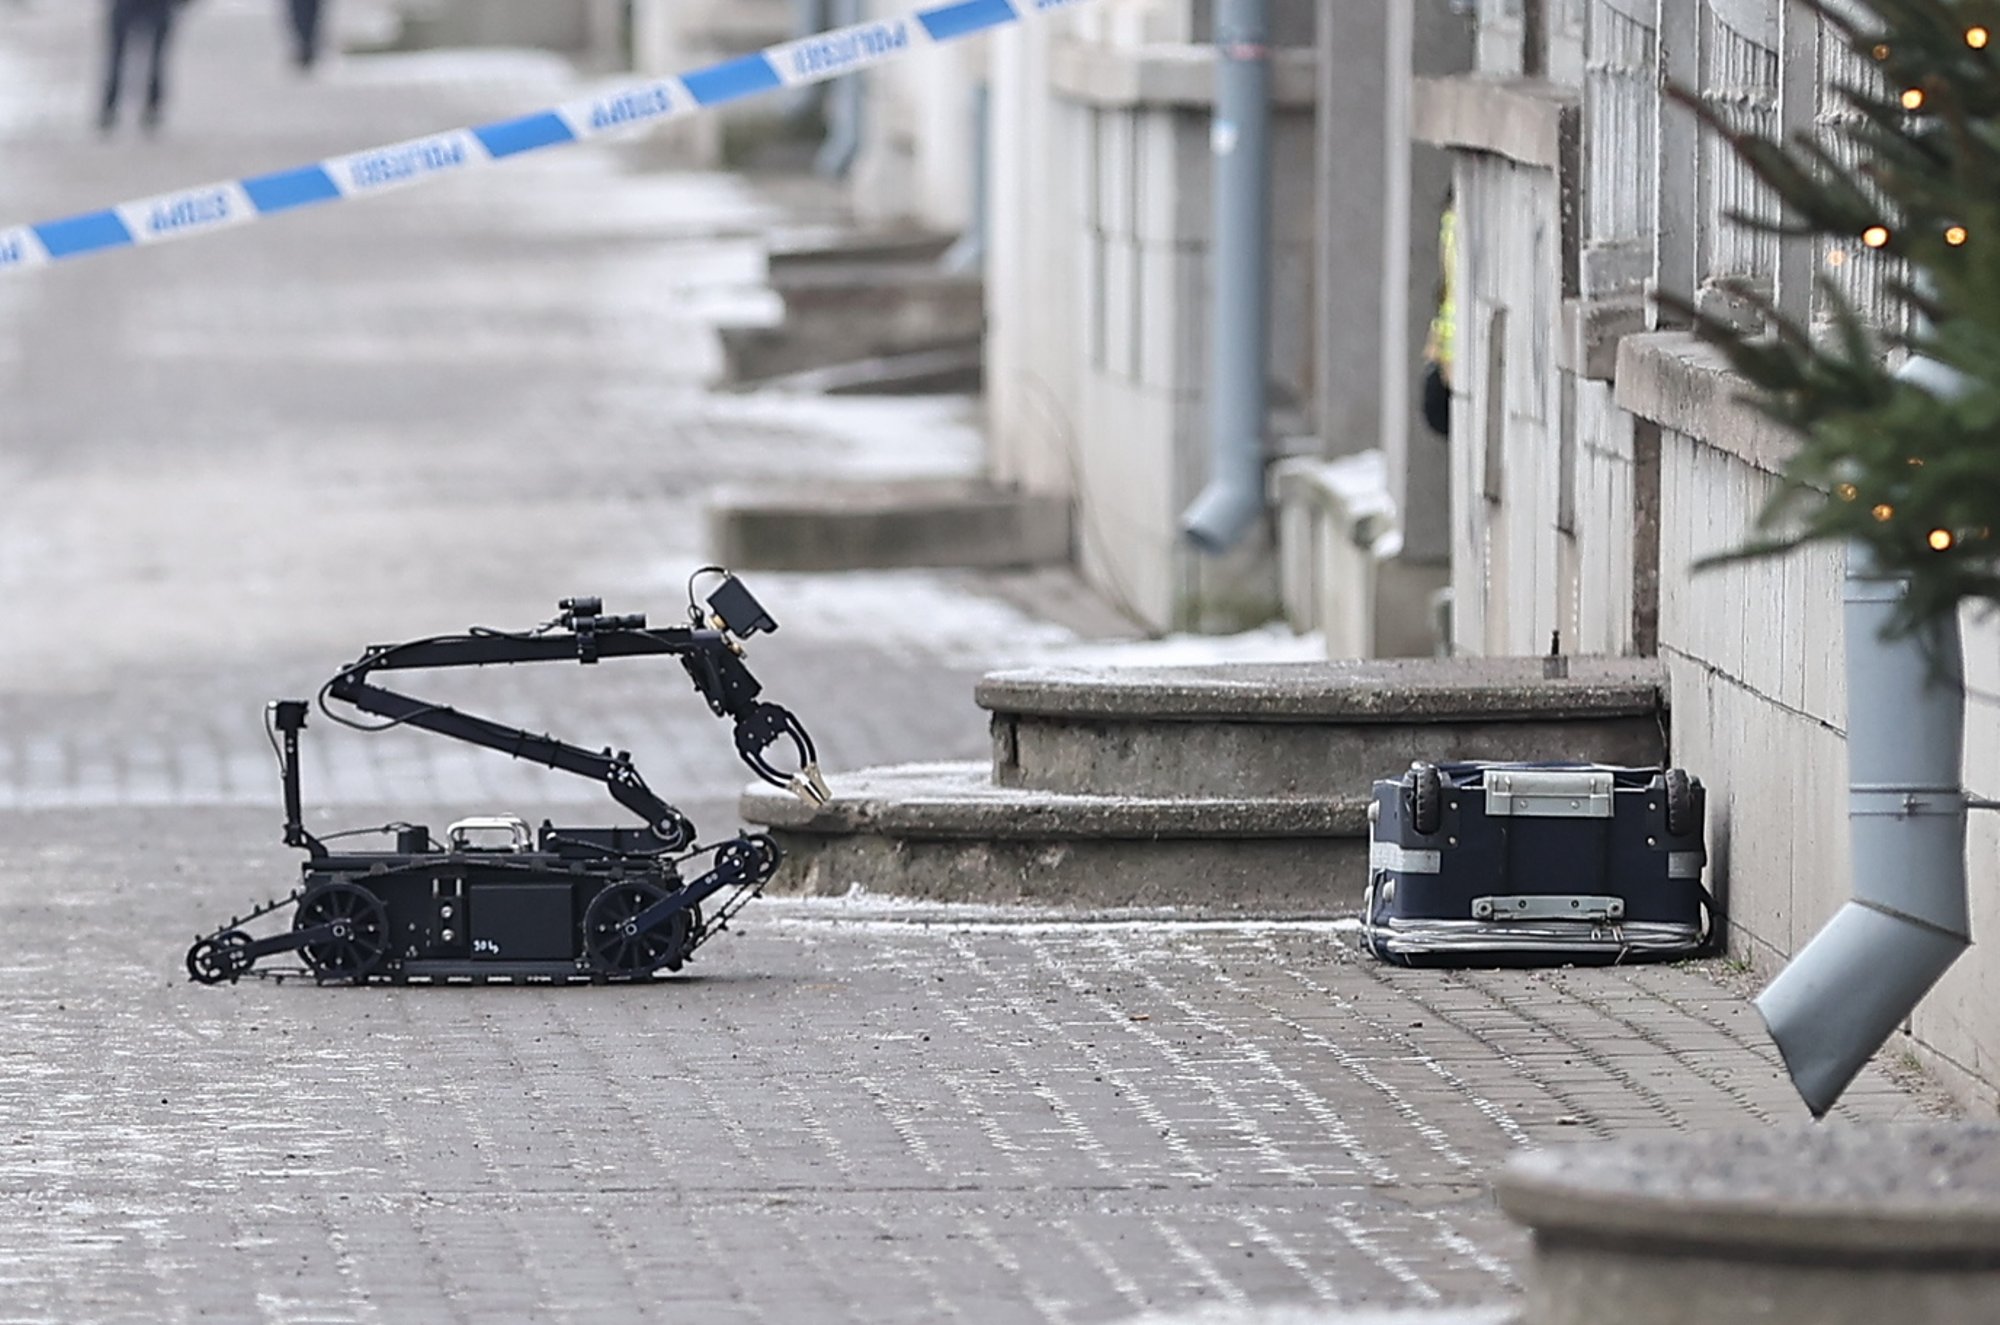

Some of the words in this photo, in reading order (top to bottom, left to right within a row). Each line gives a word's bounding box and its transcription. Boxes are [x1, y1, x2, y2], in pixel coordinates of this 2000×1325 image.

[794, 21, 908, 76] POLITSEI
[590, 84, 673, 129] STOPP
[350, 138, 466, 188] POLITSEI
